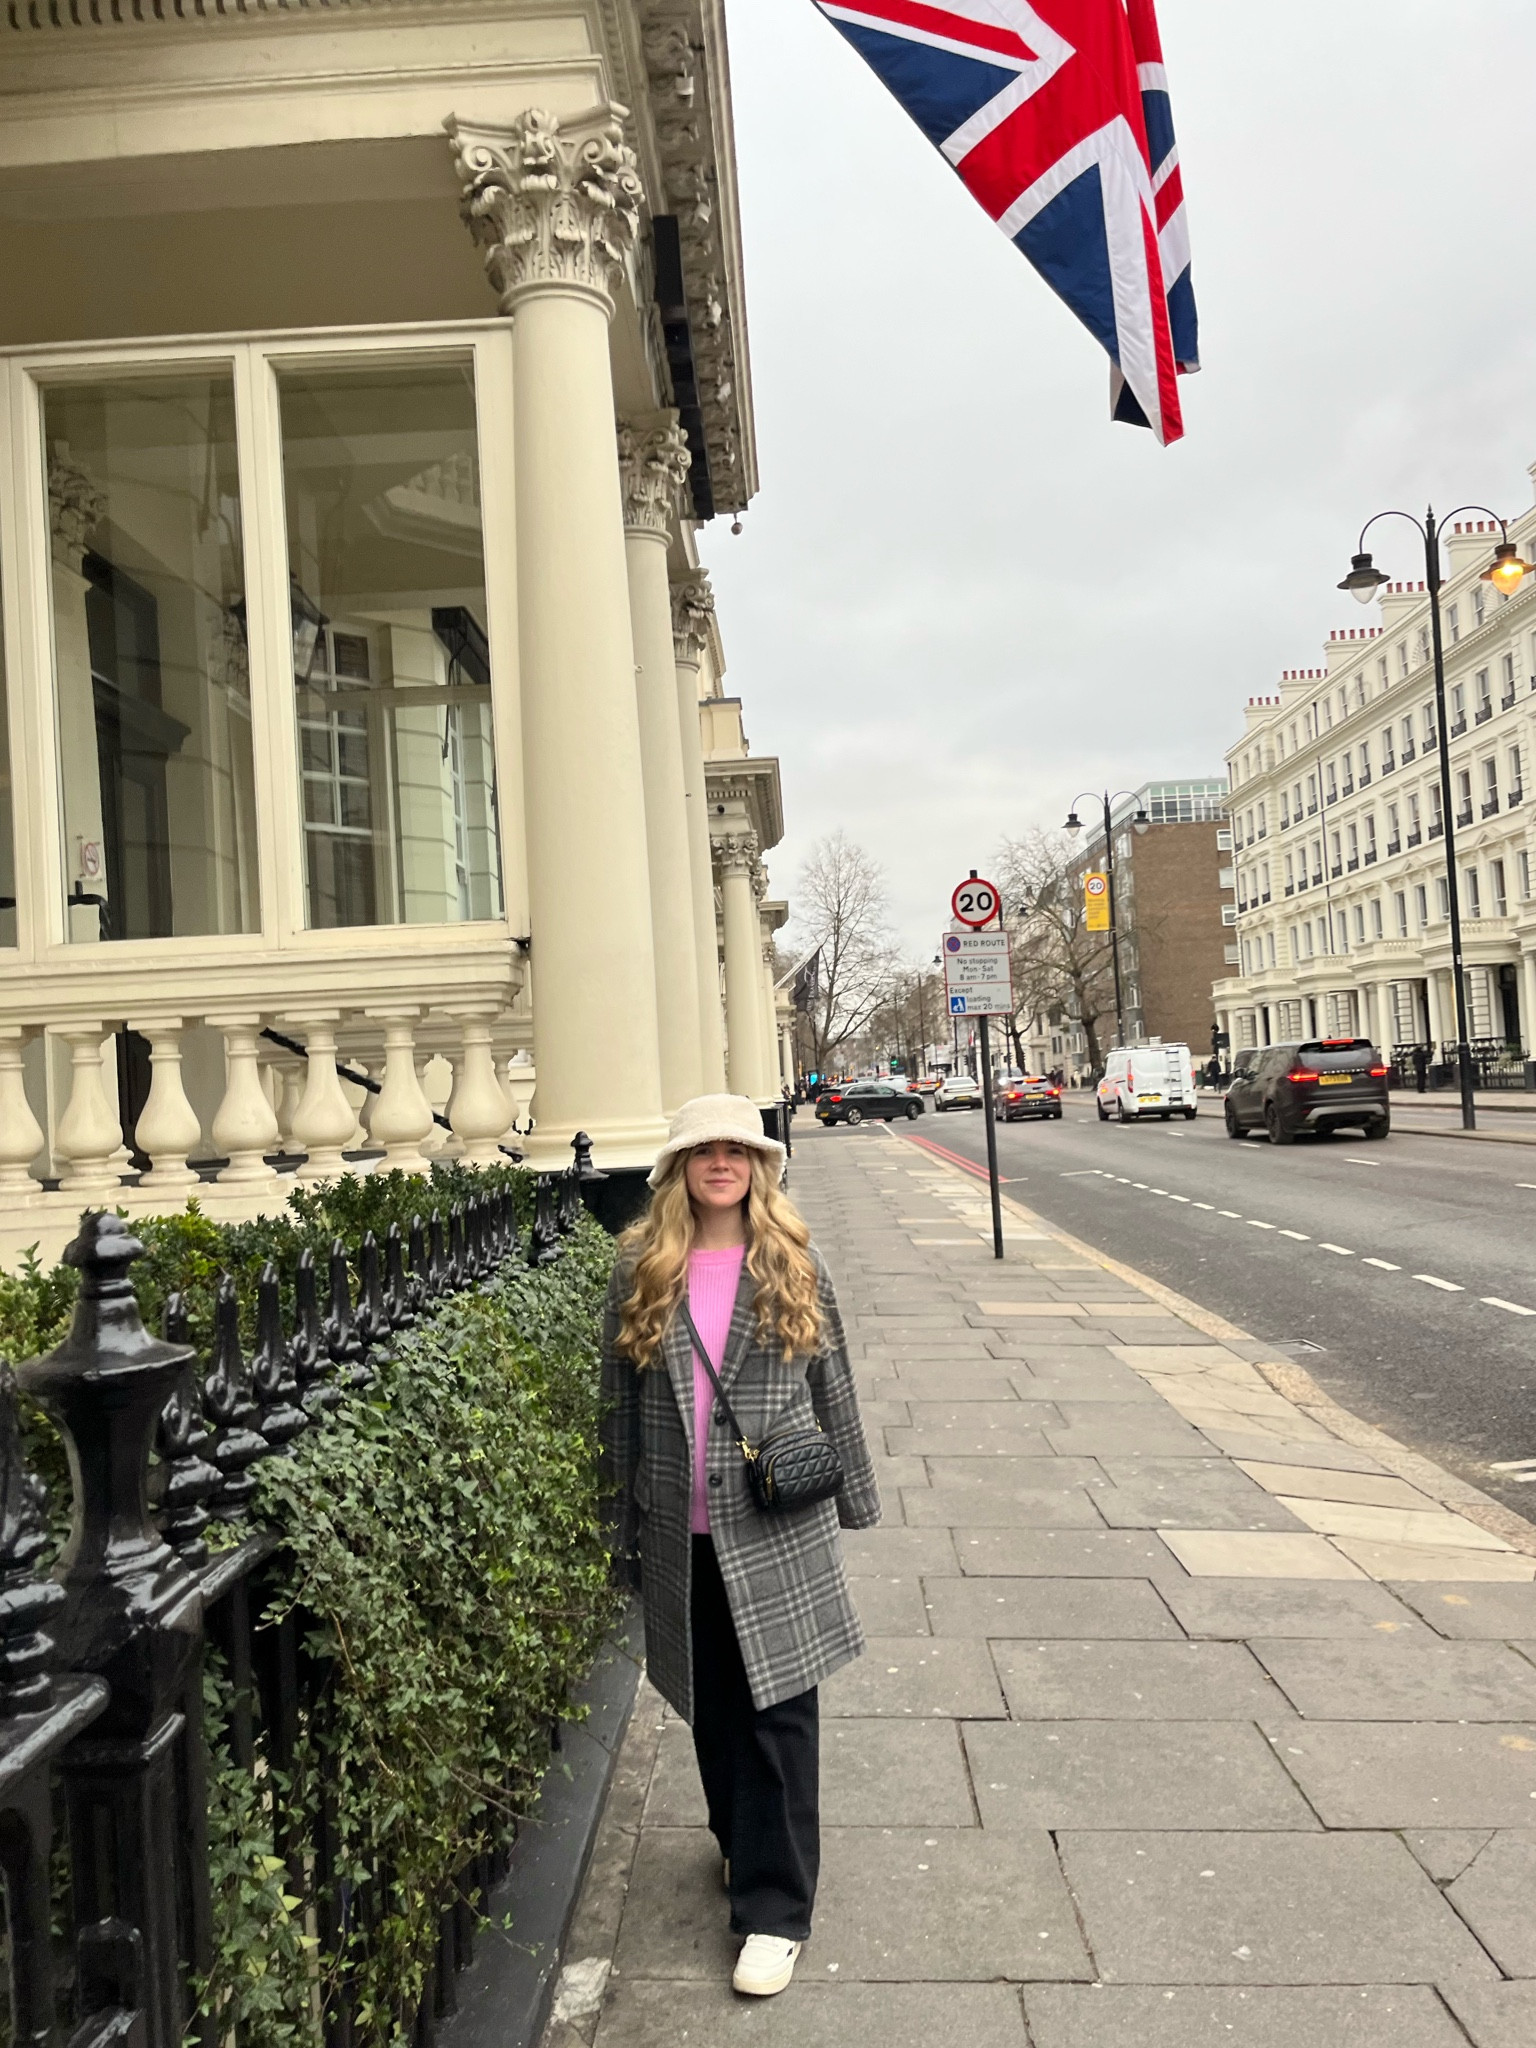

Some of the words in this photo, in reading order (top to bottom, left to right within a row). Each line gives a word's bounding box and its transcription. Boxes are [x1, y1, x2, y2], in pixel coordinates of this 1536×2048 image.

[1090, 882, 1102, 890] 20
[960, 892, 992, 912] 20
[981, 939, 1005, 947] ROUTE
